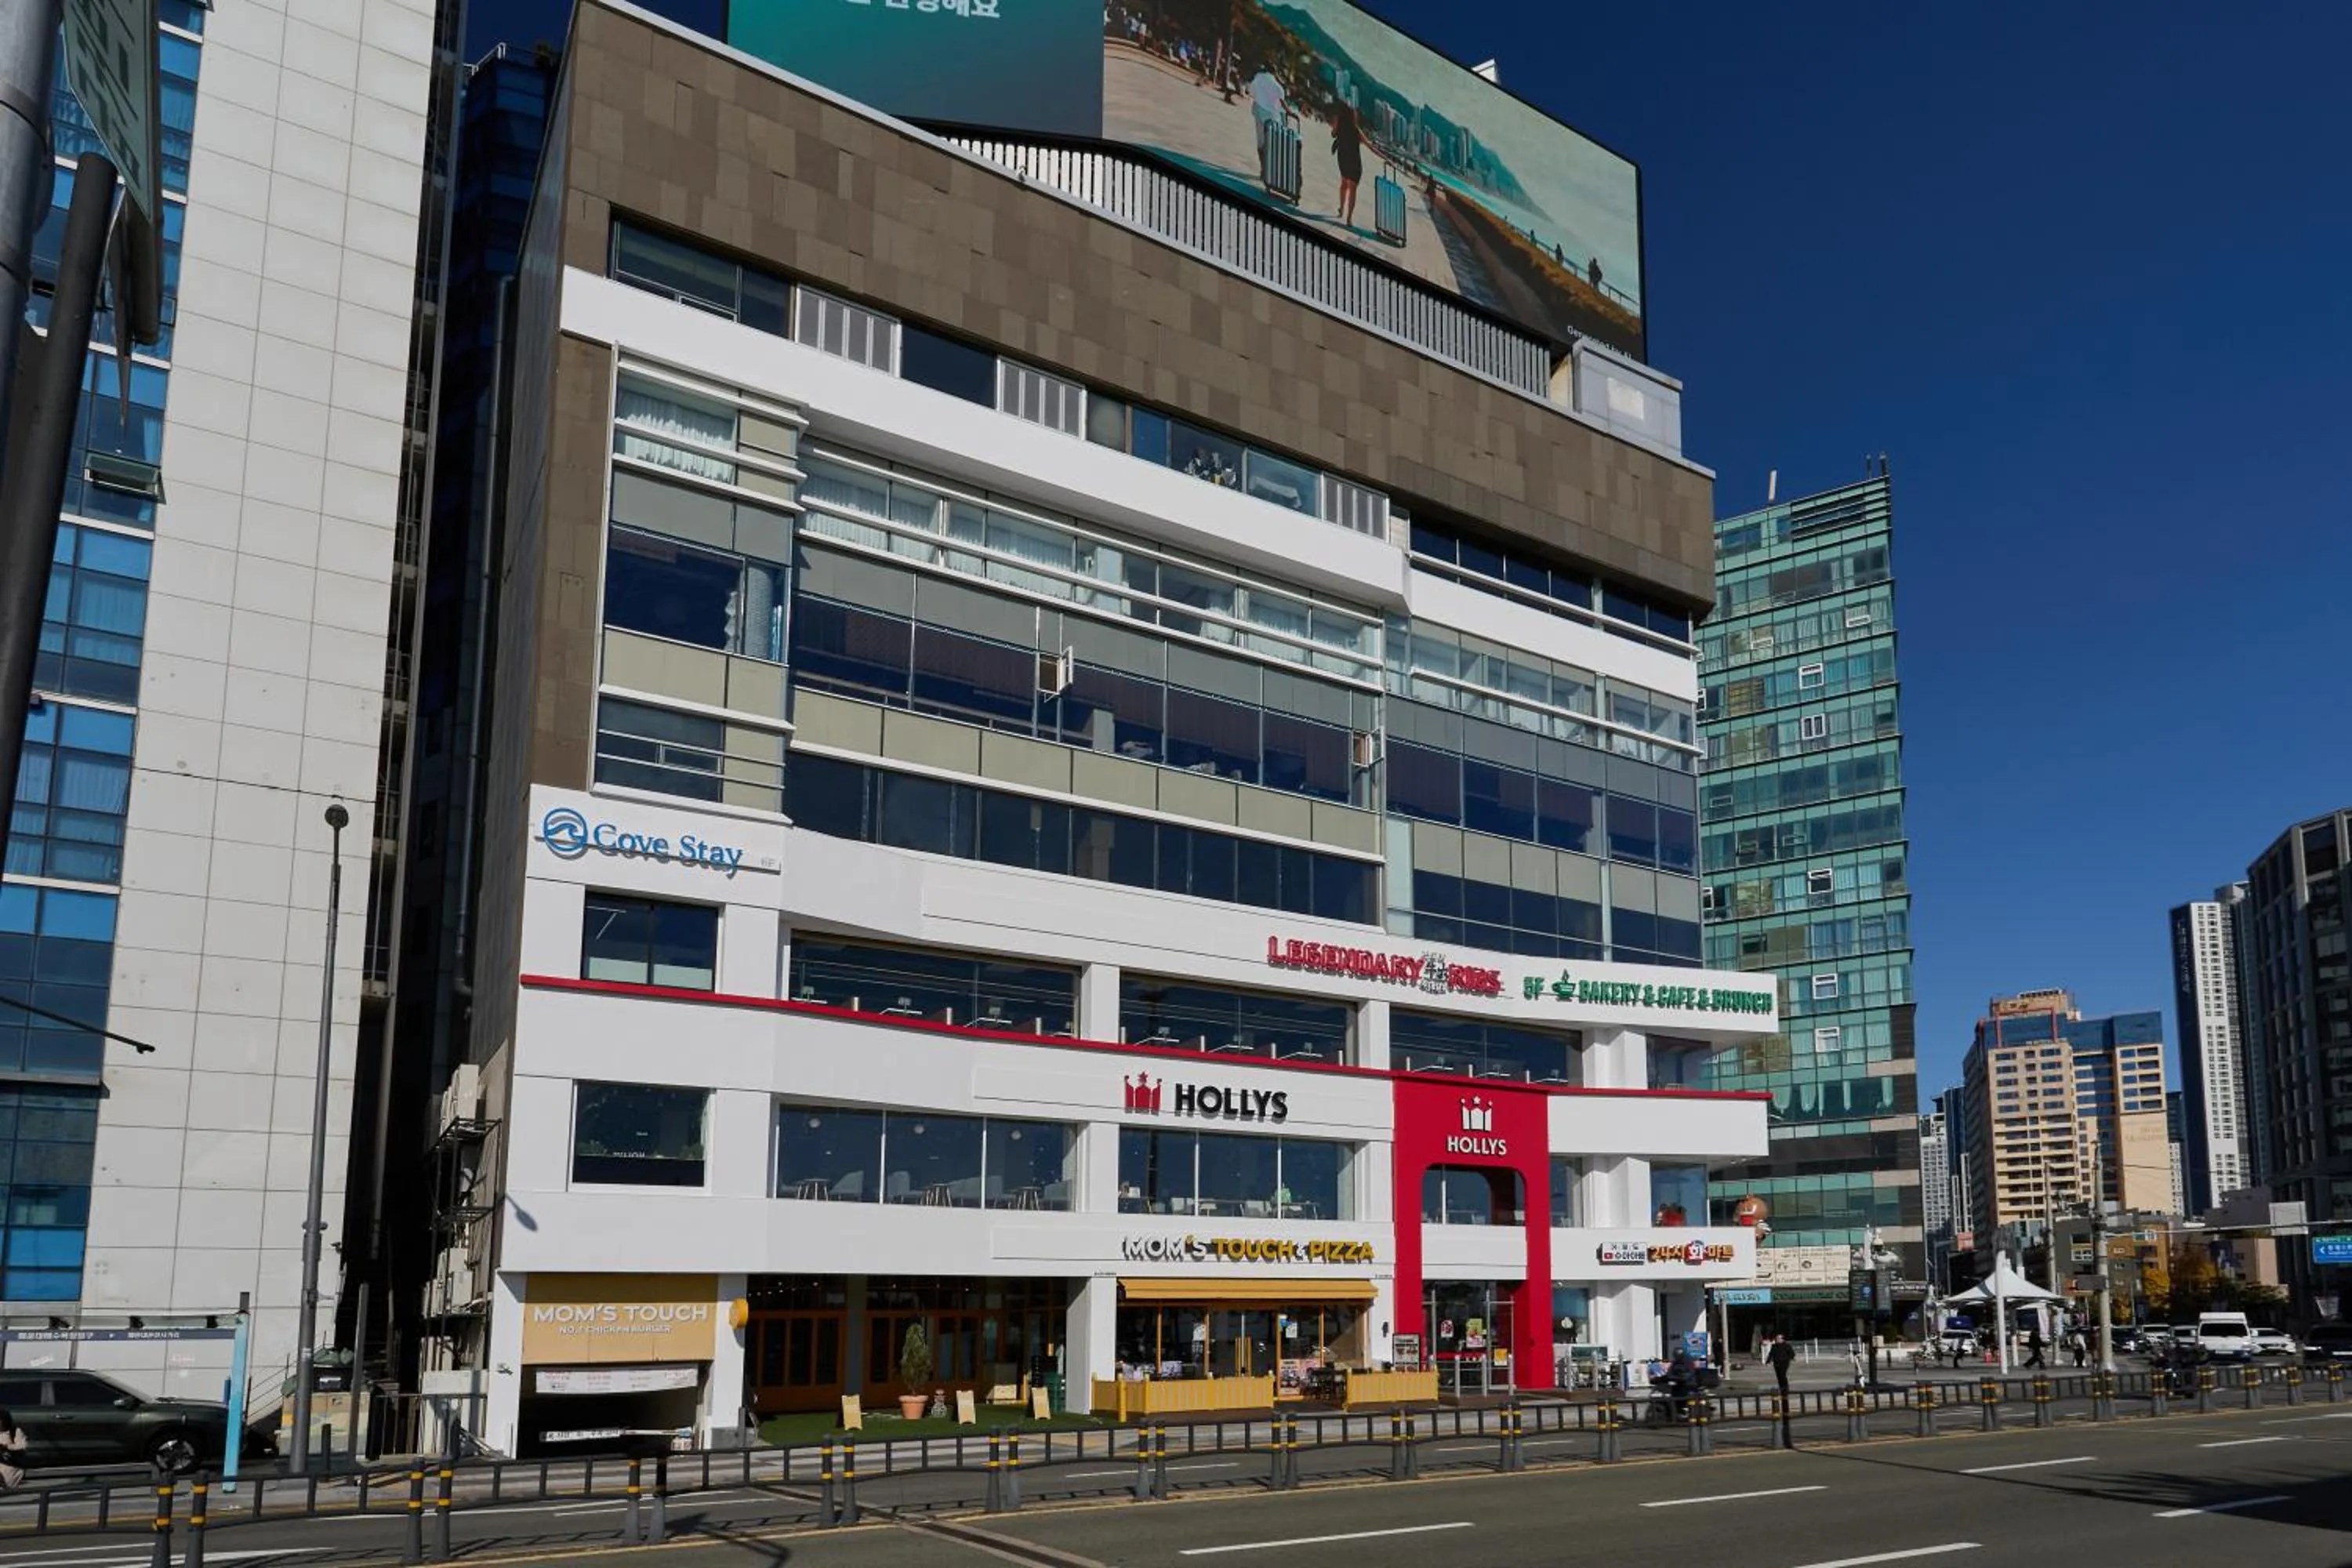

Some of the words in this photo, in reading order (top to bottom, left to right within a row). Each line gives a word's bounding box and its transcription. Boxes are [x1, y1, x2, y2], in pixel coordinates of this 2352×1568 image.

[884, 0, 1000, 18] 해요
[593, 824, 670, 855] Cove
[679, 835, 742, 868] Stay
[1268, 935, 1426, 981] LEGENDARY
[1448, 963, 1501, 993] RIBS
[1579, 980, 1642, 1003] BAKERY
[1644, 985, 1655, 1005] &
[1658, 985, 1697, 1007] CAFE
[1697, 988, 1710, 1009] &
[1711, 989, 1773, 1012] BRUNCH
[1176, 1083, 1288, 1119] HOLLYS
[1447, 1135, 1507, 1156] HOLLYS
[1123, 1235, 1207, 1258] MOM'S
[1210, 1238, 1293, 1260] TOUCH
[1309, 1241, 1374, 1260] PIZZA
[534, 1305, 618, 1323] MOM'S
[622, 1304, 707, 1322] TOUCH
